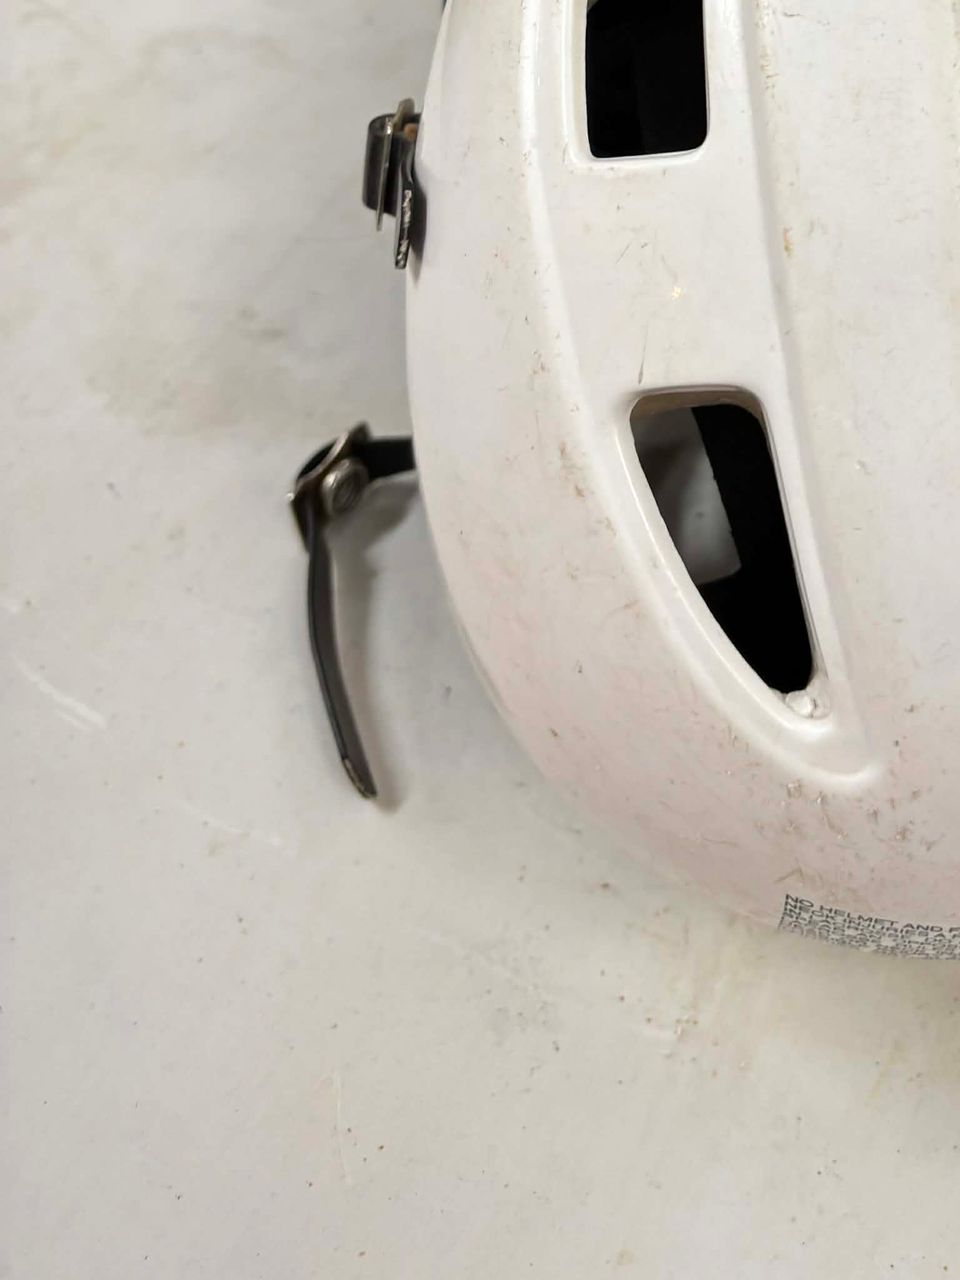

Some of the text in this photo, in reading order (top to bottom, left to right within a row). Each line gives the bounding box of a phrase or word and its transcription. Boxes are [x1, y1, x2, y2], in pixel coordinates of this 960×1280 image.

[785, 893, 814, 909] NO
[819, 904, 900, 927] HELMET
[902, 923, 943, 933] AND
